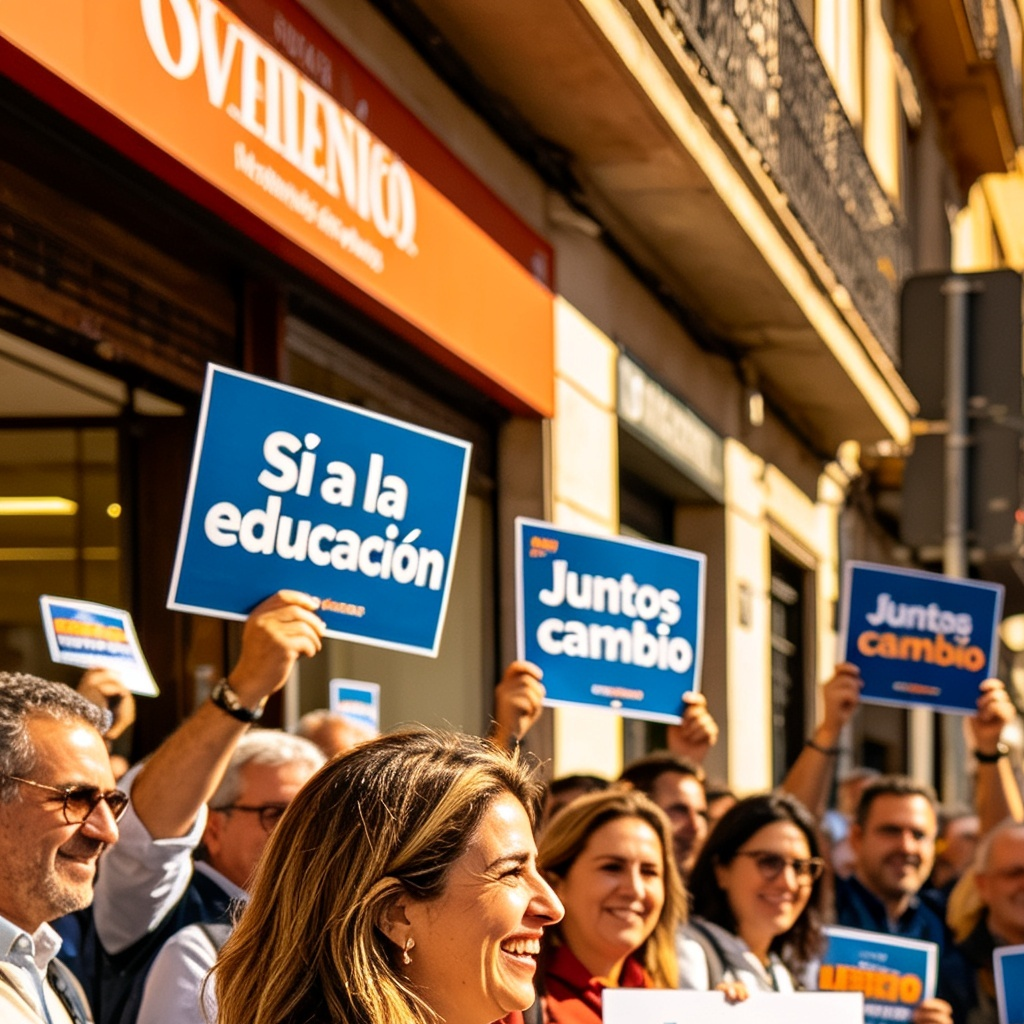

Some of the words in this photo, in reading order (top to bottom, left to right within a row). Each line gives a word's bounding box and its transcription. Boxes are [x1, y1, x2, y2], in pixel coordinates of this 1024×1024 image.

[320, 461, 356, 507] a
[363, 453, 408, 520] la
[204, 495, 444, 590] educación
[538, 560, 682, 625] Juntos
[865, 593, 973, 635] Juntos
[536, 618, 693, 674] cambio
[857, 630, 986, 673] cambio
